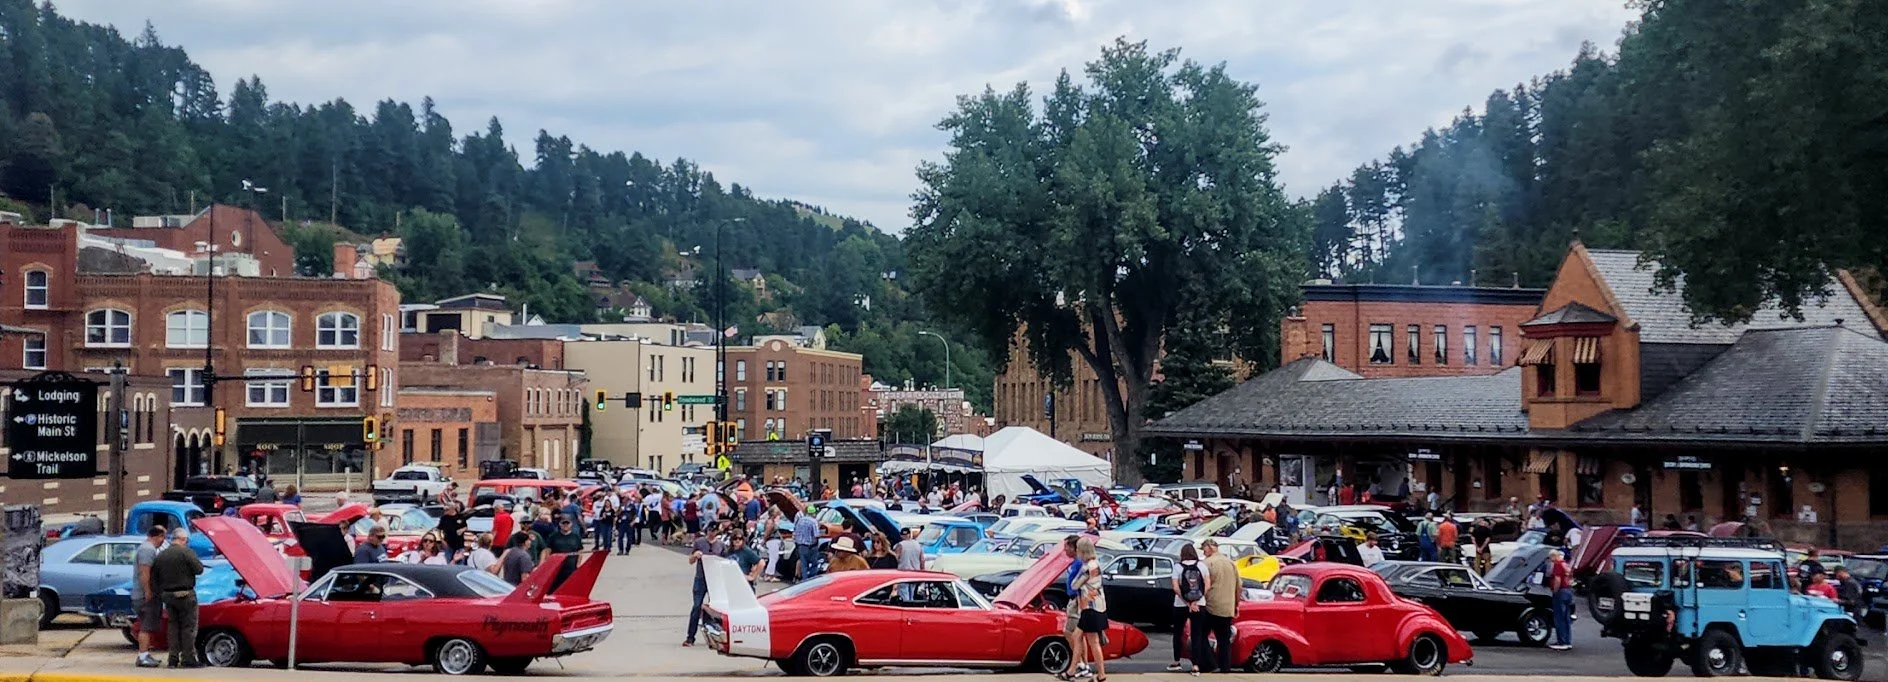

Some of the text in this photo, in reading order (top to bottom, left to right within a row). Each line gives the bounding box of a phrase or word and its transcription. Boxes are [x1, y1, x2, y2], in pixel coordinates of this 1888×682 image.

[38, 389, 79, 403] Lodging
[37, 413, 77, 424] Historic
[37, 426, 75, 437] Main St
[36, 451, 87, 461] Mickelson
[36, 463, 59, 474] Trail
[732, 625, 767, 633] DAYTONA
